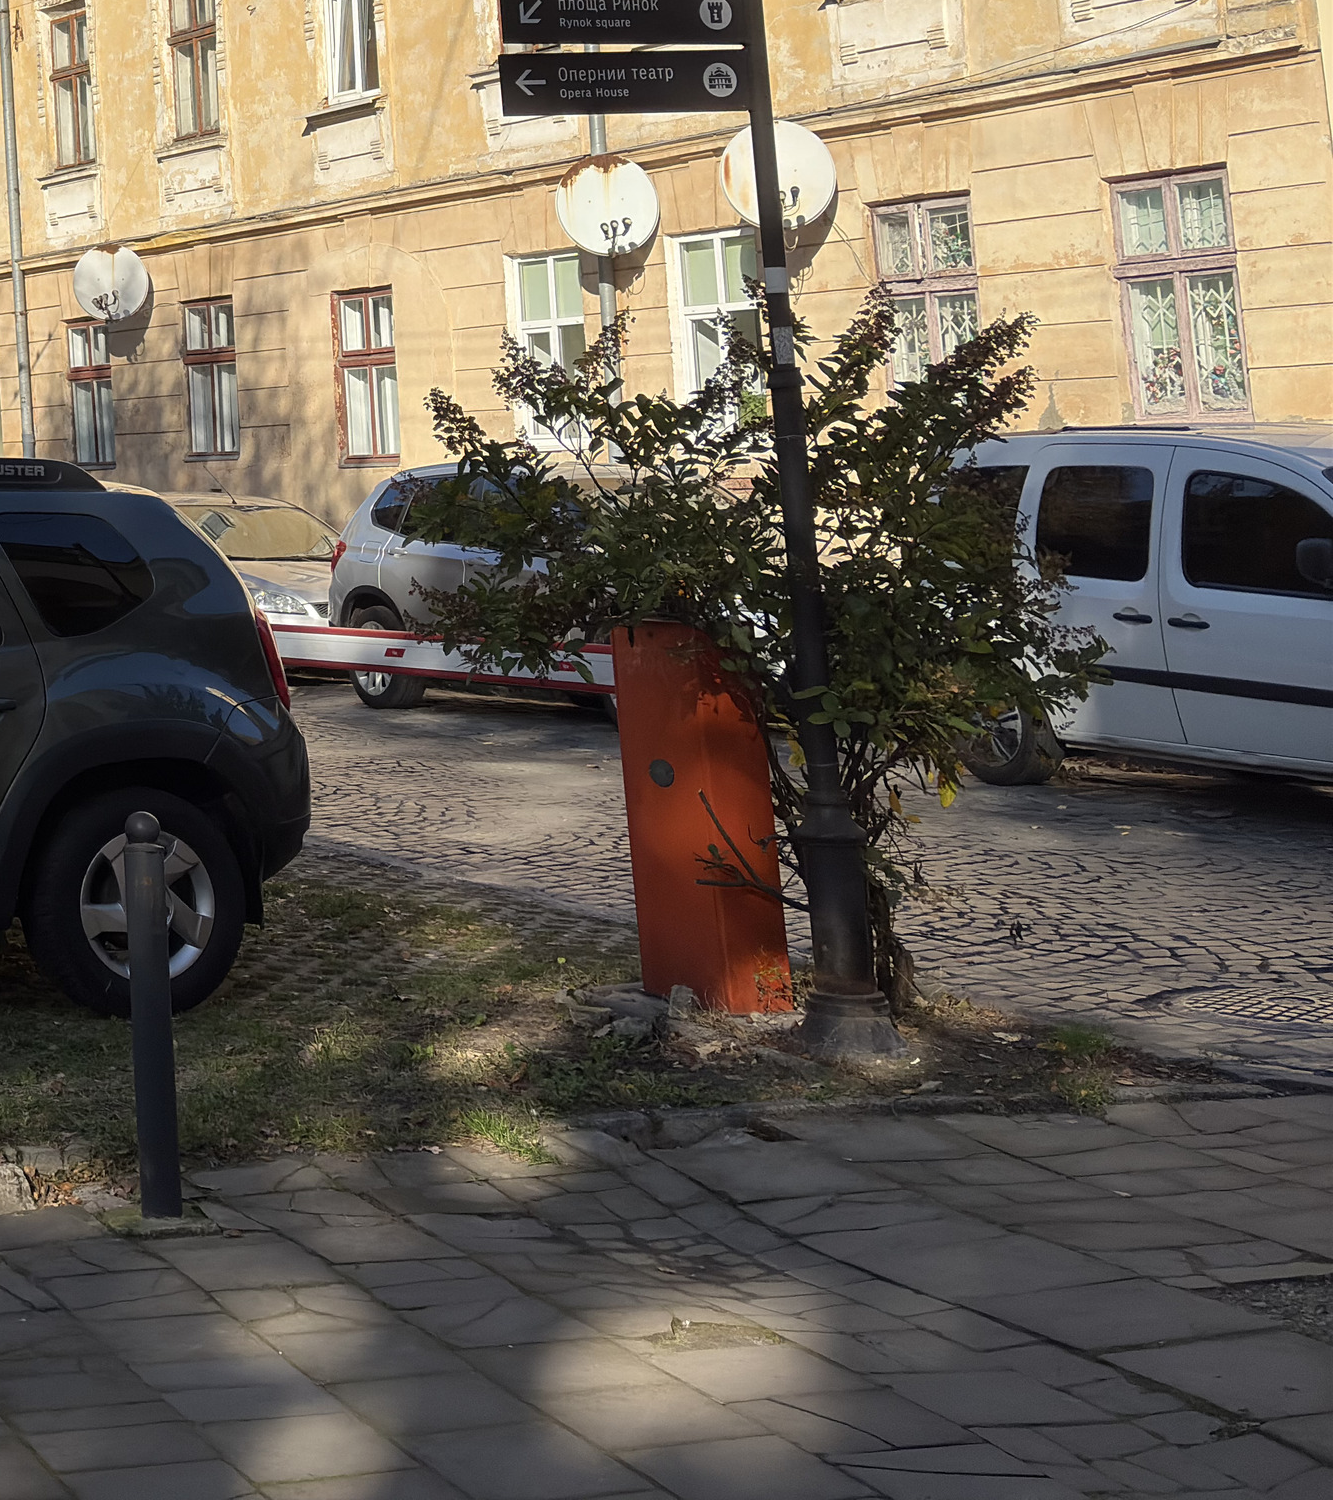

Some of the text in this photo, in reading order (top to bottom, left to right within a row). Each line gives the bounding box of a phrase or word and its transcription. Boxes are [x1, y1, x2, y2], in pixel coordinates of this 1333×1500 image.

[559, 17, 631, 29] Rynok square
[631, 66, 674, 82] театр
[559, 87, 630, 100] Opera House
